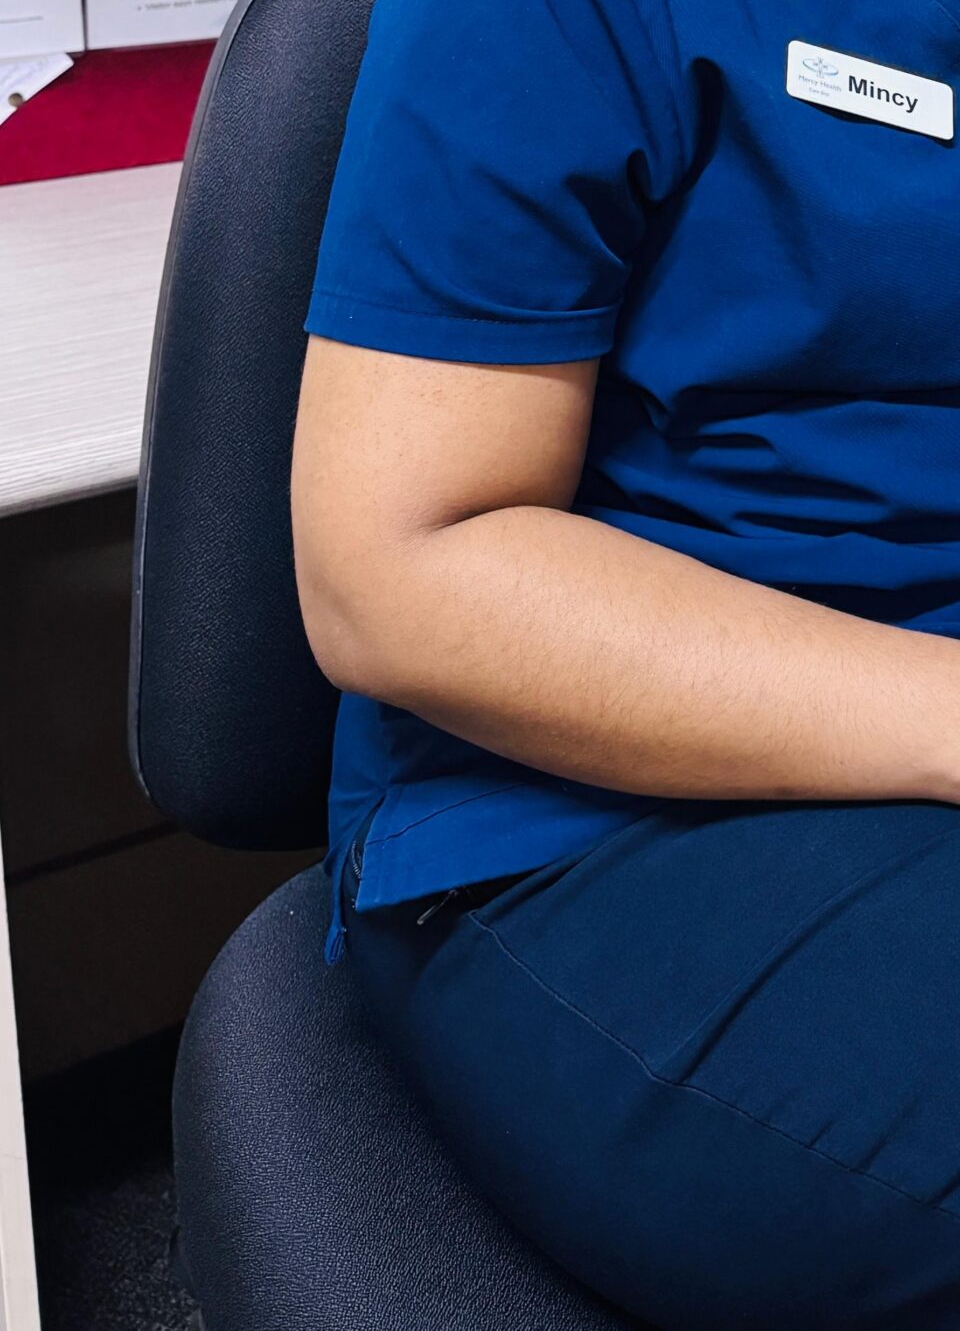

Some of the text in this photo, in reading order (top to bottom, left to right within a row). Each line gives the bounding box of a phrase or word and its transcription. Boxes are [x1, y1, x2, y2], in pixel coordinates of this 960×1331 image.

[798, 74, 842, 92] Mercy Health
[848, 75, 918, 113] Mincy
